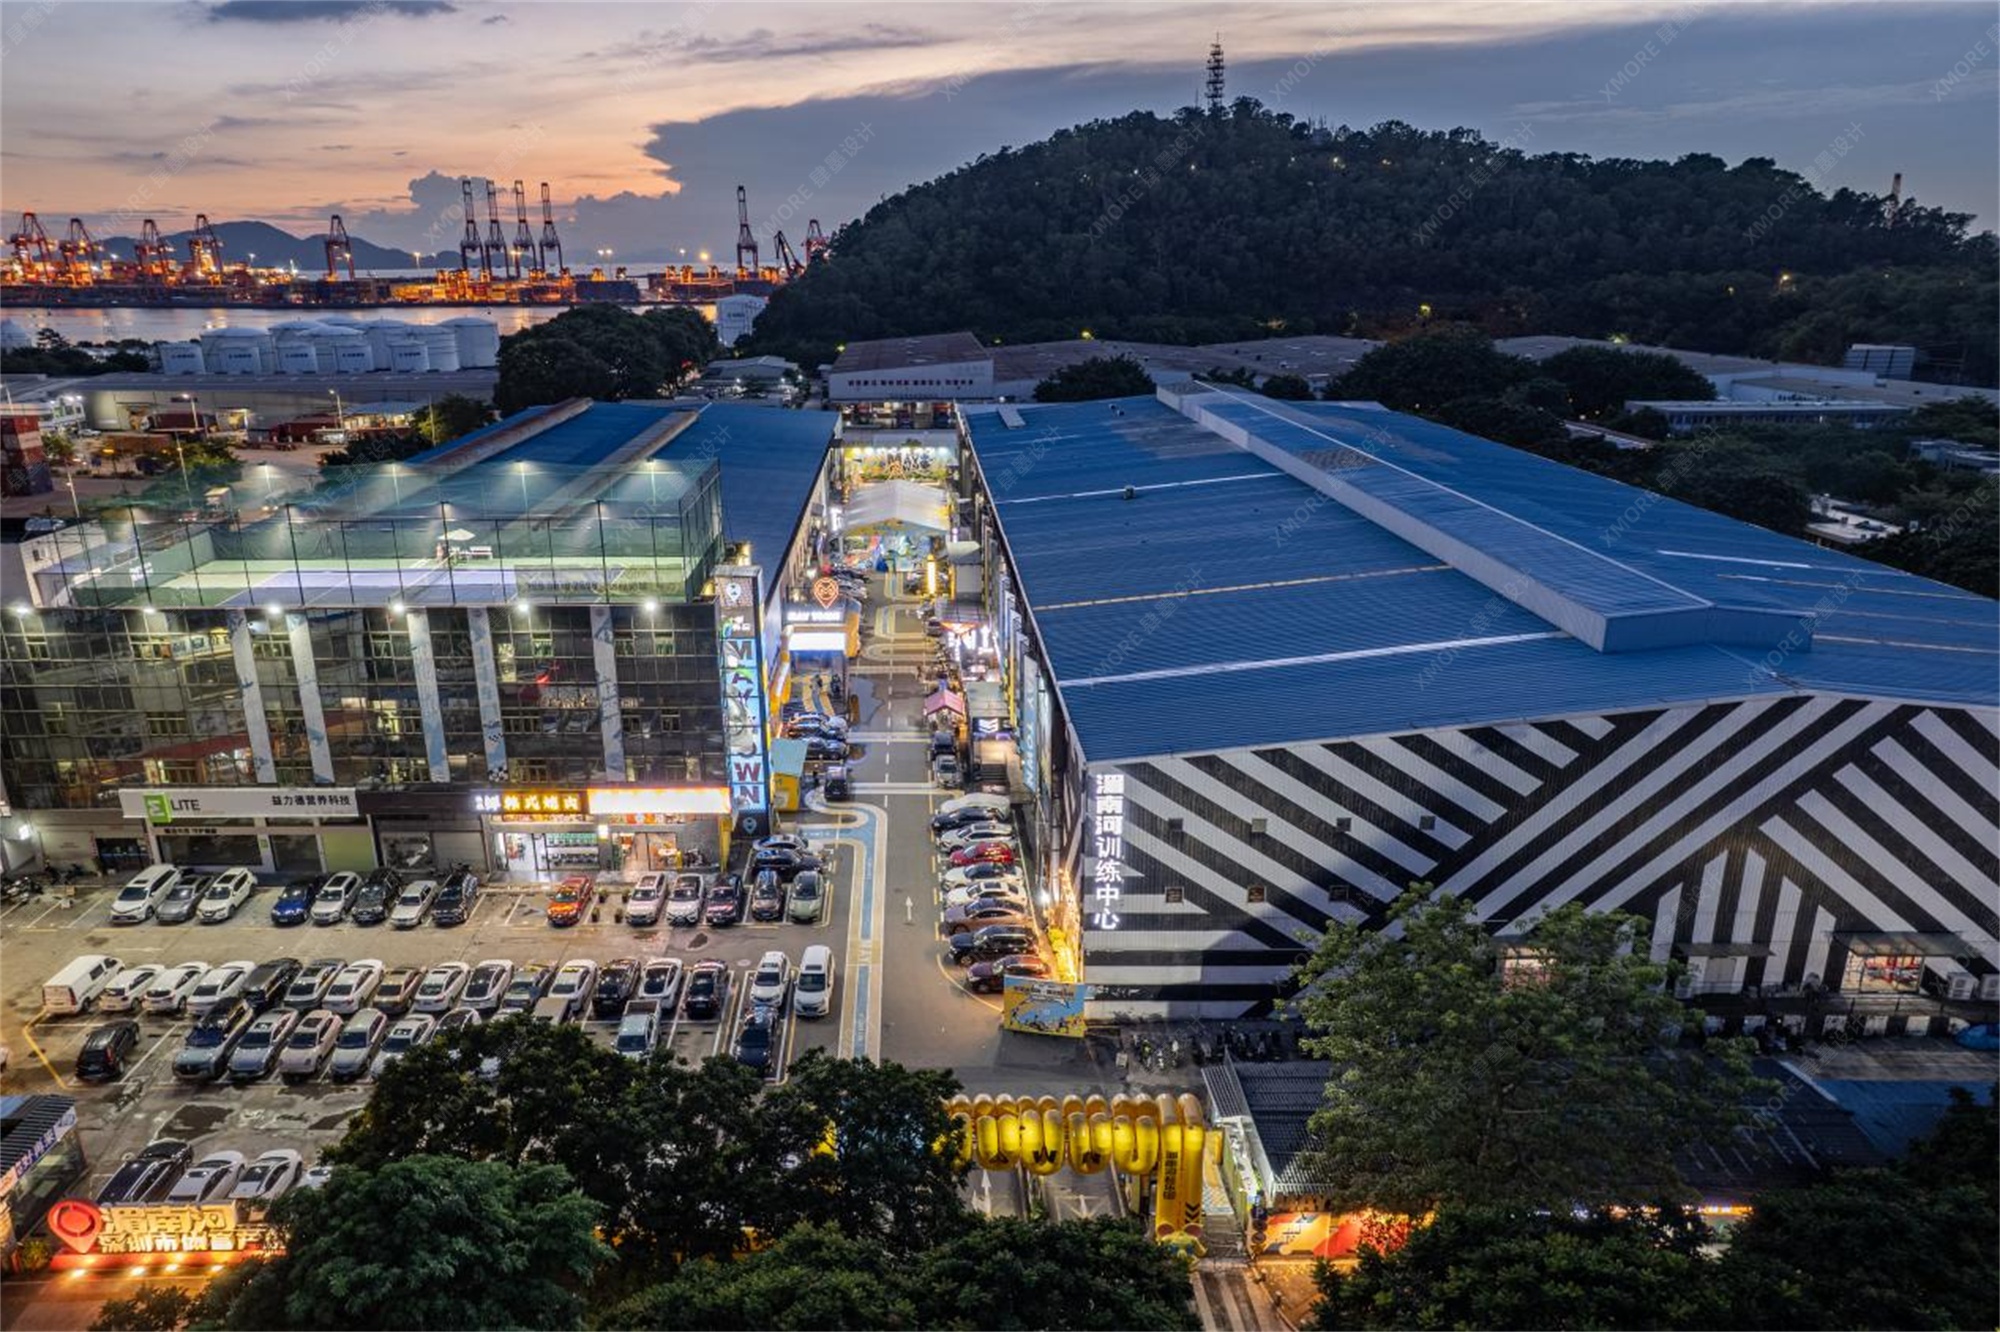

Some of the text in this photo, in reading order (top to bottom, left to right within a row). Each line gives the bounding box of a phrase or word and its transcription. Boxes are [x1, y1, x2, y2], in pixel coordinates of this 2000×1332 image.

[1094, 774, 1125, 930] 湄南河训练中心
